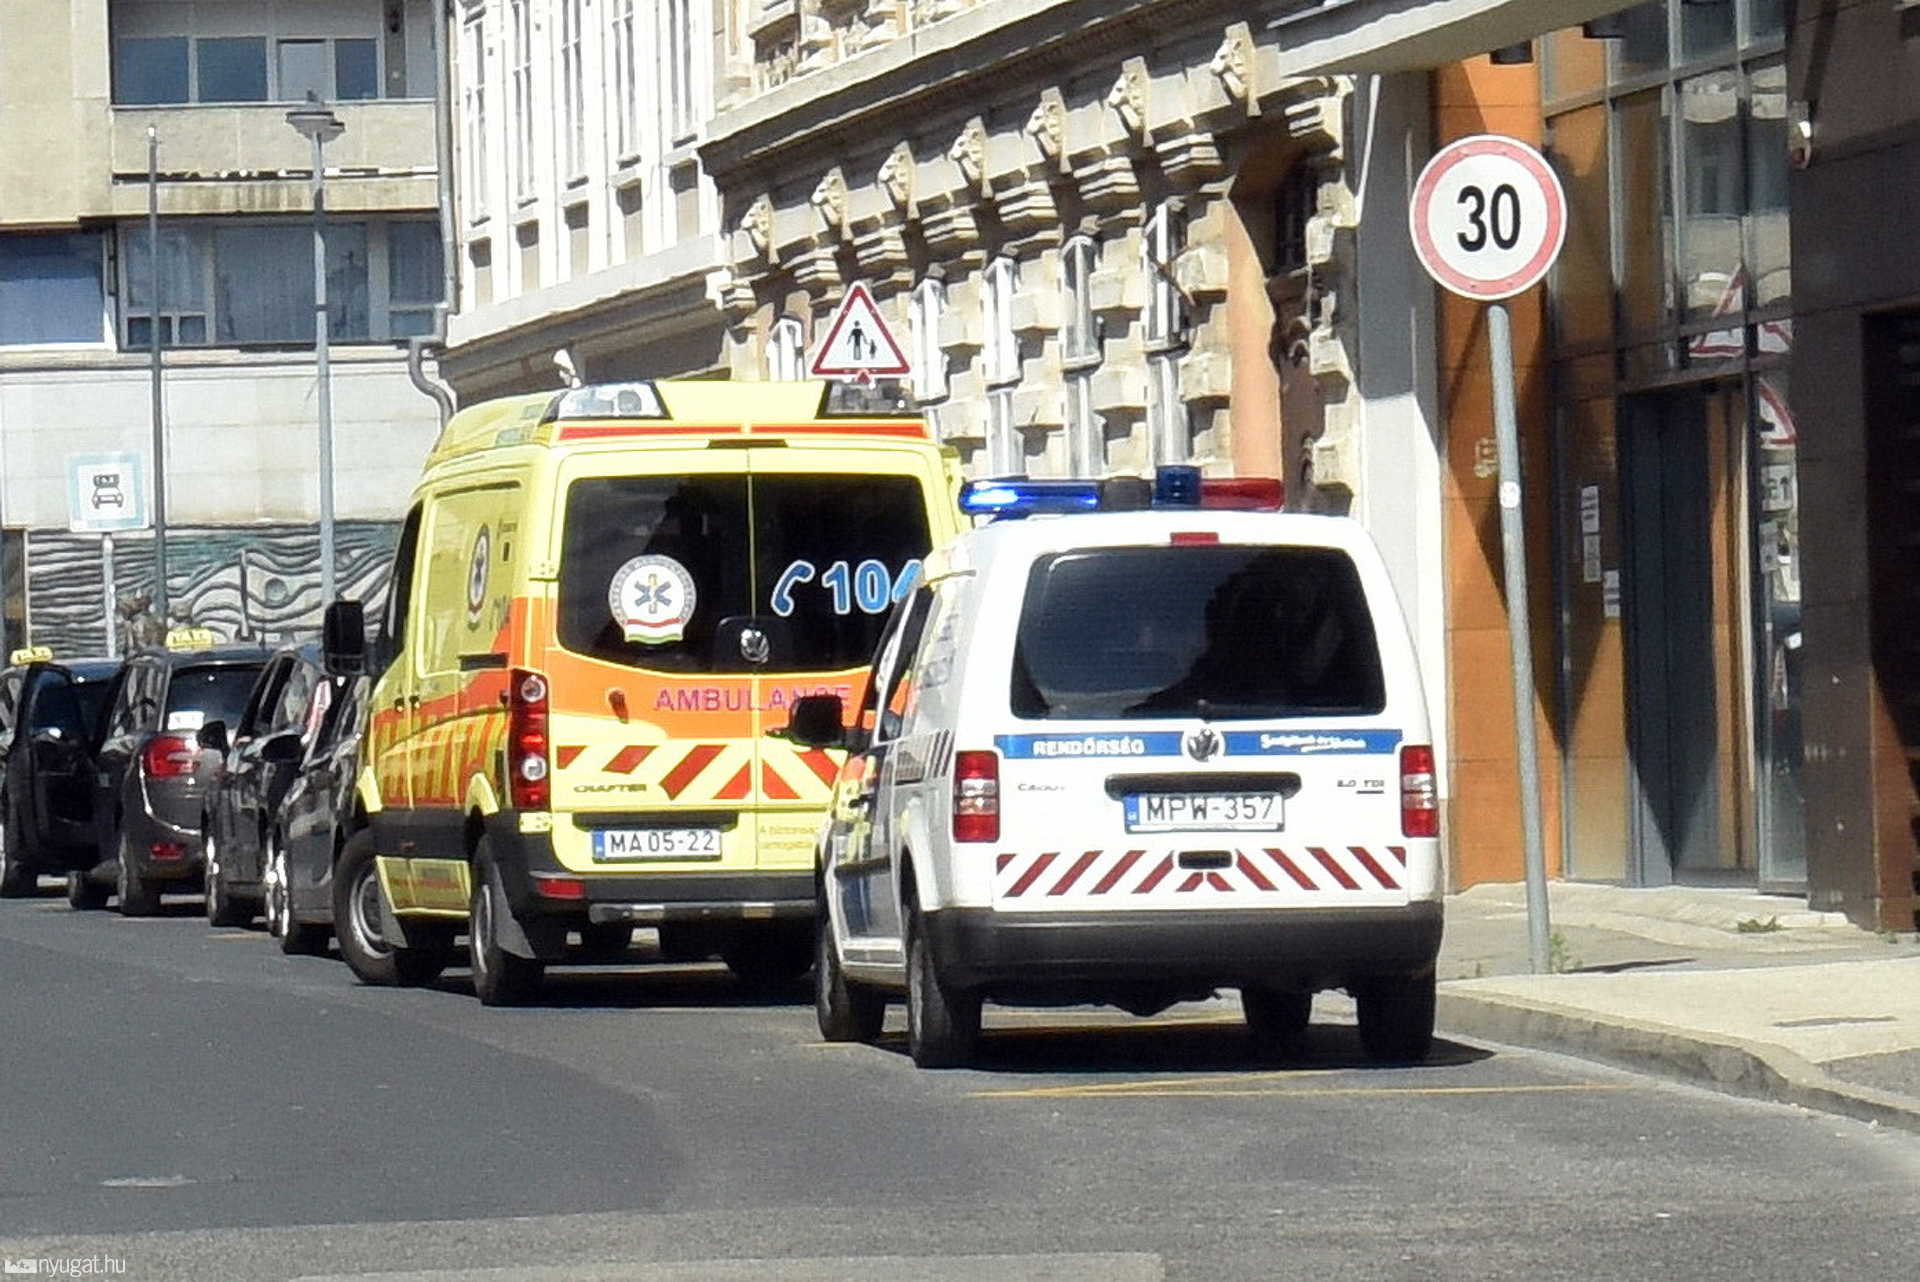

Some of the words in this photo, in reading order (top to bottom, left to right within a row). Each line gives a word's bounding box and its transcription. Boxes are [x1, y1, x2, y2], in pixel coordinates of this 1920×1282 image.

[1457, 183, 1521, 252] 30
[1147, 795, 1275, 821] MPW-357
[610, 834, 642, 853] MA
[649, 830, 714, 852] 05-22
